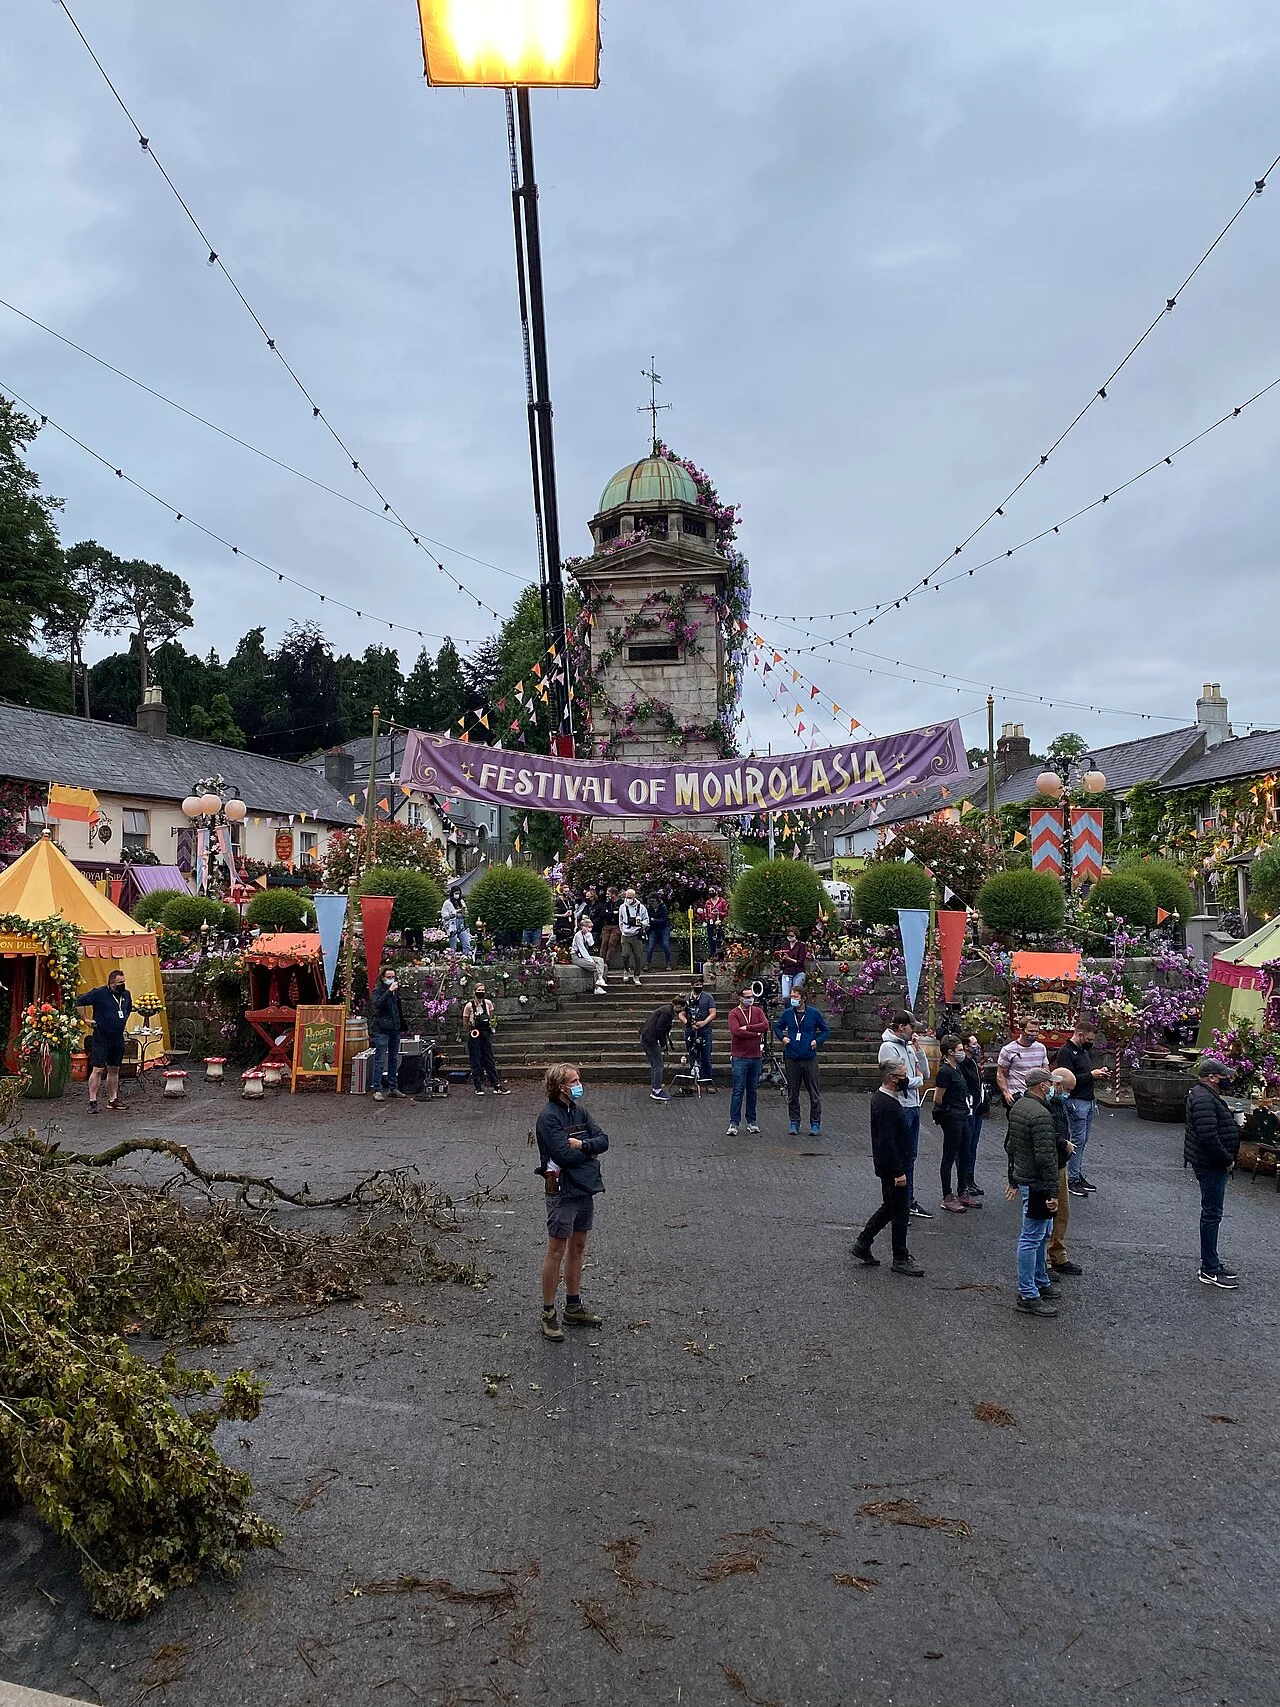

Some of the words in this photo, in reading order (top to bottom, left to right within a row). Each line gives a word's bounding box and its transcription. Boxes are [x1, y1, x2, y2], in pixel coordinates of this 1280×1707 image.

[479, 763, 618, 804] FESTIVAL
[628, 778, 666, 805] OF
[675, 750, 887, 812] MONROLASIA
[17, 941, 38, 949] PIES
